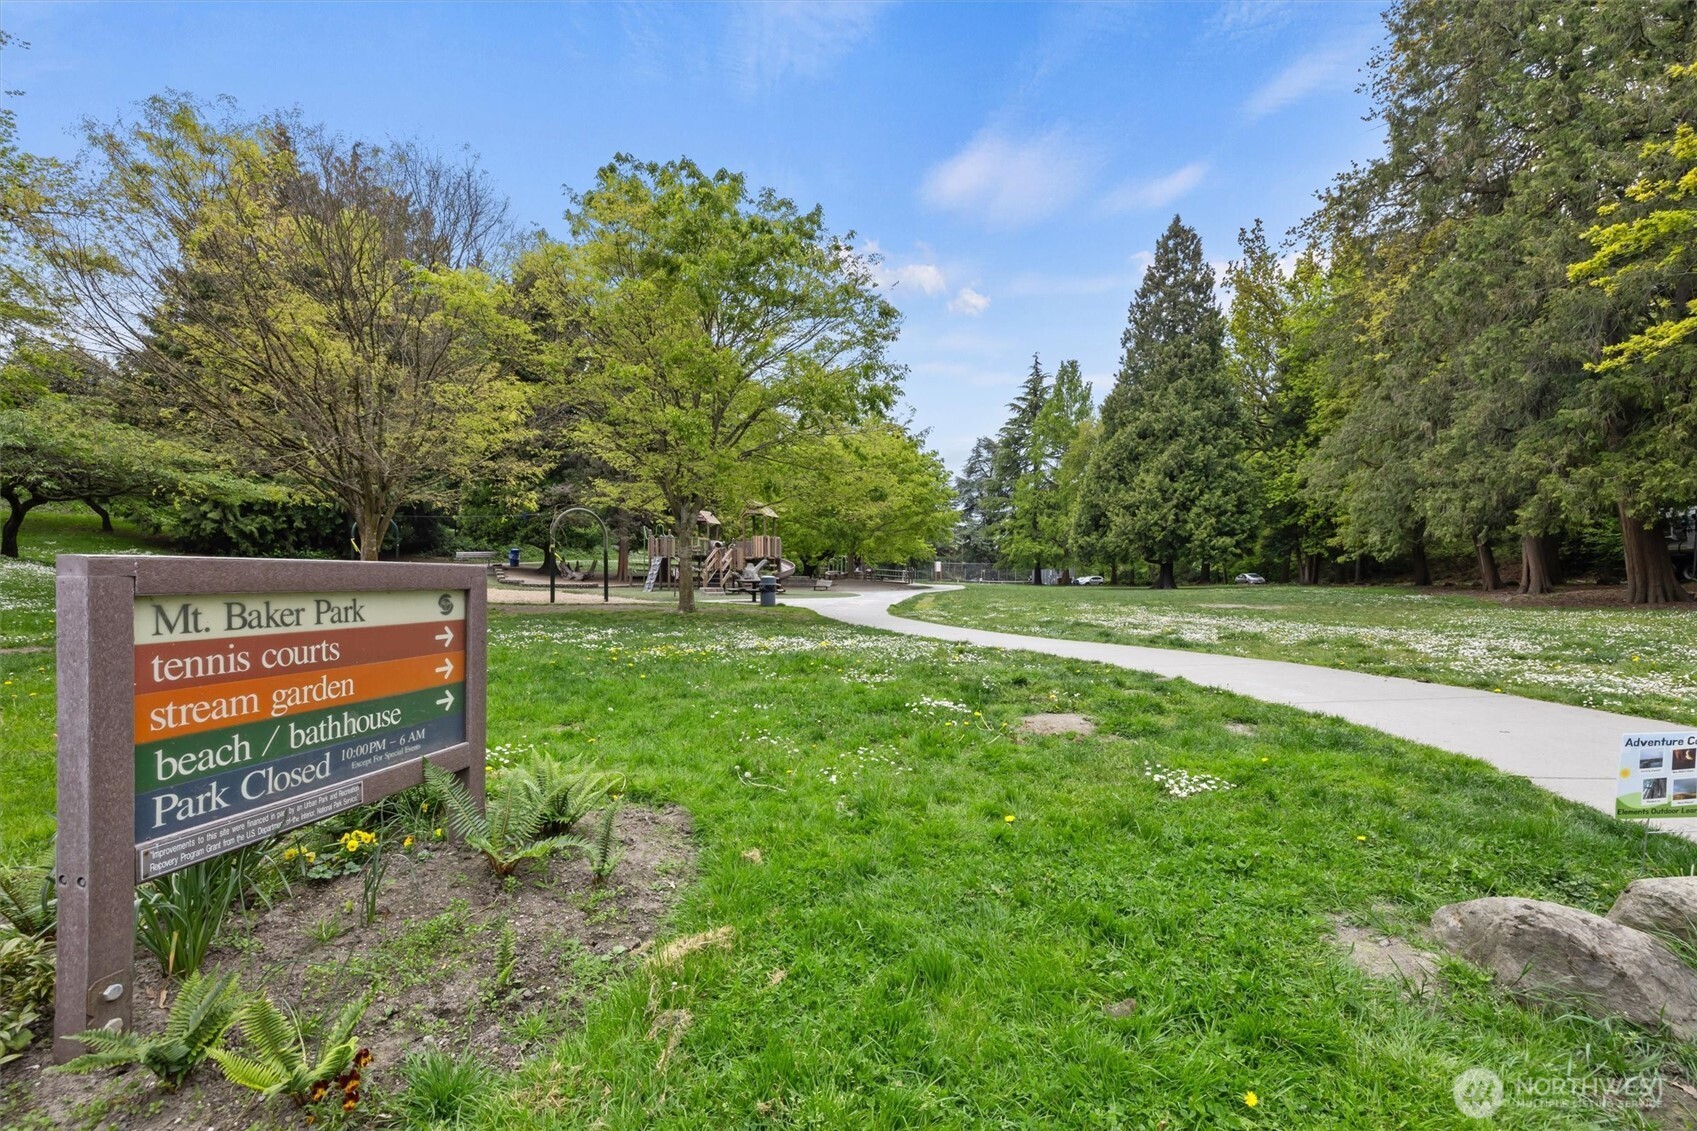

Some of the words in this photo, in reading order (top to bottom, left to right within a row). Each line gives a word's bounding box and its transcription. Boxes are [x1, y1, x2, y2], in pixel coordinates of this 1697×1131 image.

[152, 603, 210, 636] Mt.
[224, 600, 305, 631] Baker
[314, 598, 366, 625] Park
[151, 643, 250, 683] tennis
[261, 640, 340, 669] courts
[150, 693, 260, 732] stream
[270, 674, 355, 717] garden
[154, 733, 252, 781] beach
[261, 725, 281, 756] /
[289, 708, 401, 749] bathhouse
[351, 756, 372, 769] Except
[373, 753, 383, 764] For
[384, 748, 404, 760] Special
[404, 743, 422, 754] Events
[1625, 737, 1684, 747] Adventure
[151, 781, 230, 828] Park
[241, 752, 332, 800] Closed
[341, 738, 387, 761] 10:00PM
[399, 734, 406, 746] 6
[408, 728, 426, 743] AM
[149, 856, 179, 873] Recovery
[180, 847, 205, 863] Program
[205, 841, 221, 853] Grant
[222, 837, 235, 847] from
[236, 834, 245, 843] the
[316, 803, 333, 815] National
[197, 836, 205, 844] to
[206, 831, 217, 842] this
[219, 827, 230, 838] site
[231, 822, 245, 833] were
[246, 814, 269, 828] financed
[270, 812, 276, 820] in
[276, 810, 286, 819] par
[288, 806, 295, 816] by
[296, 804, 303, 812] an
[303, 799, 318, 809] Urban
[318, 795, 329, 804] Park
[329, 791, 338, 801] and
[338, 785, 360, 798] Recreation
